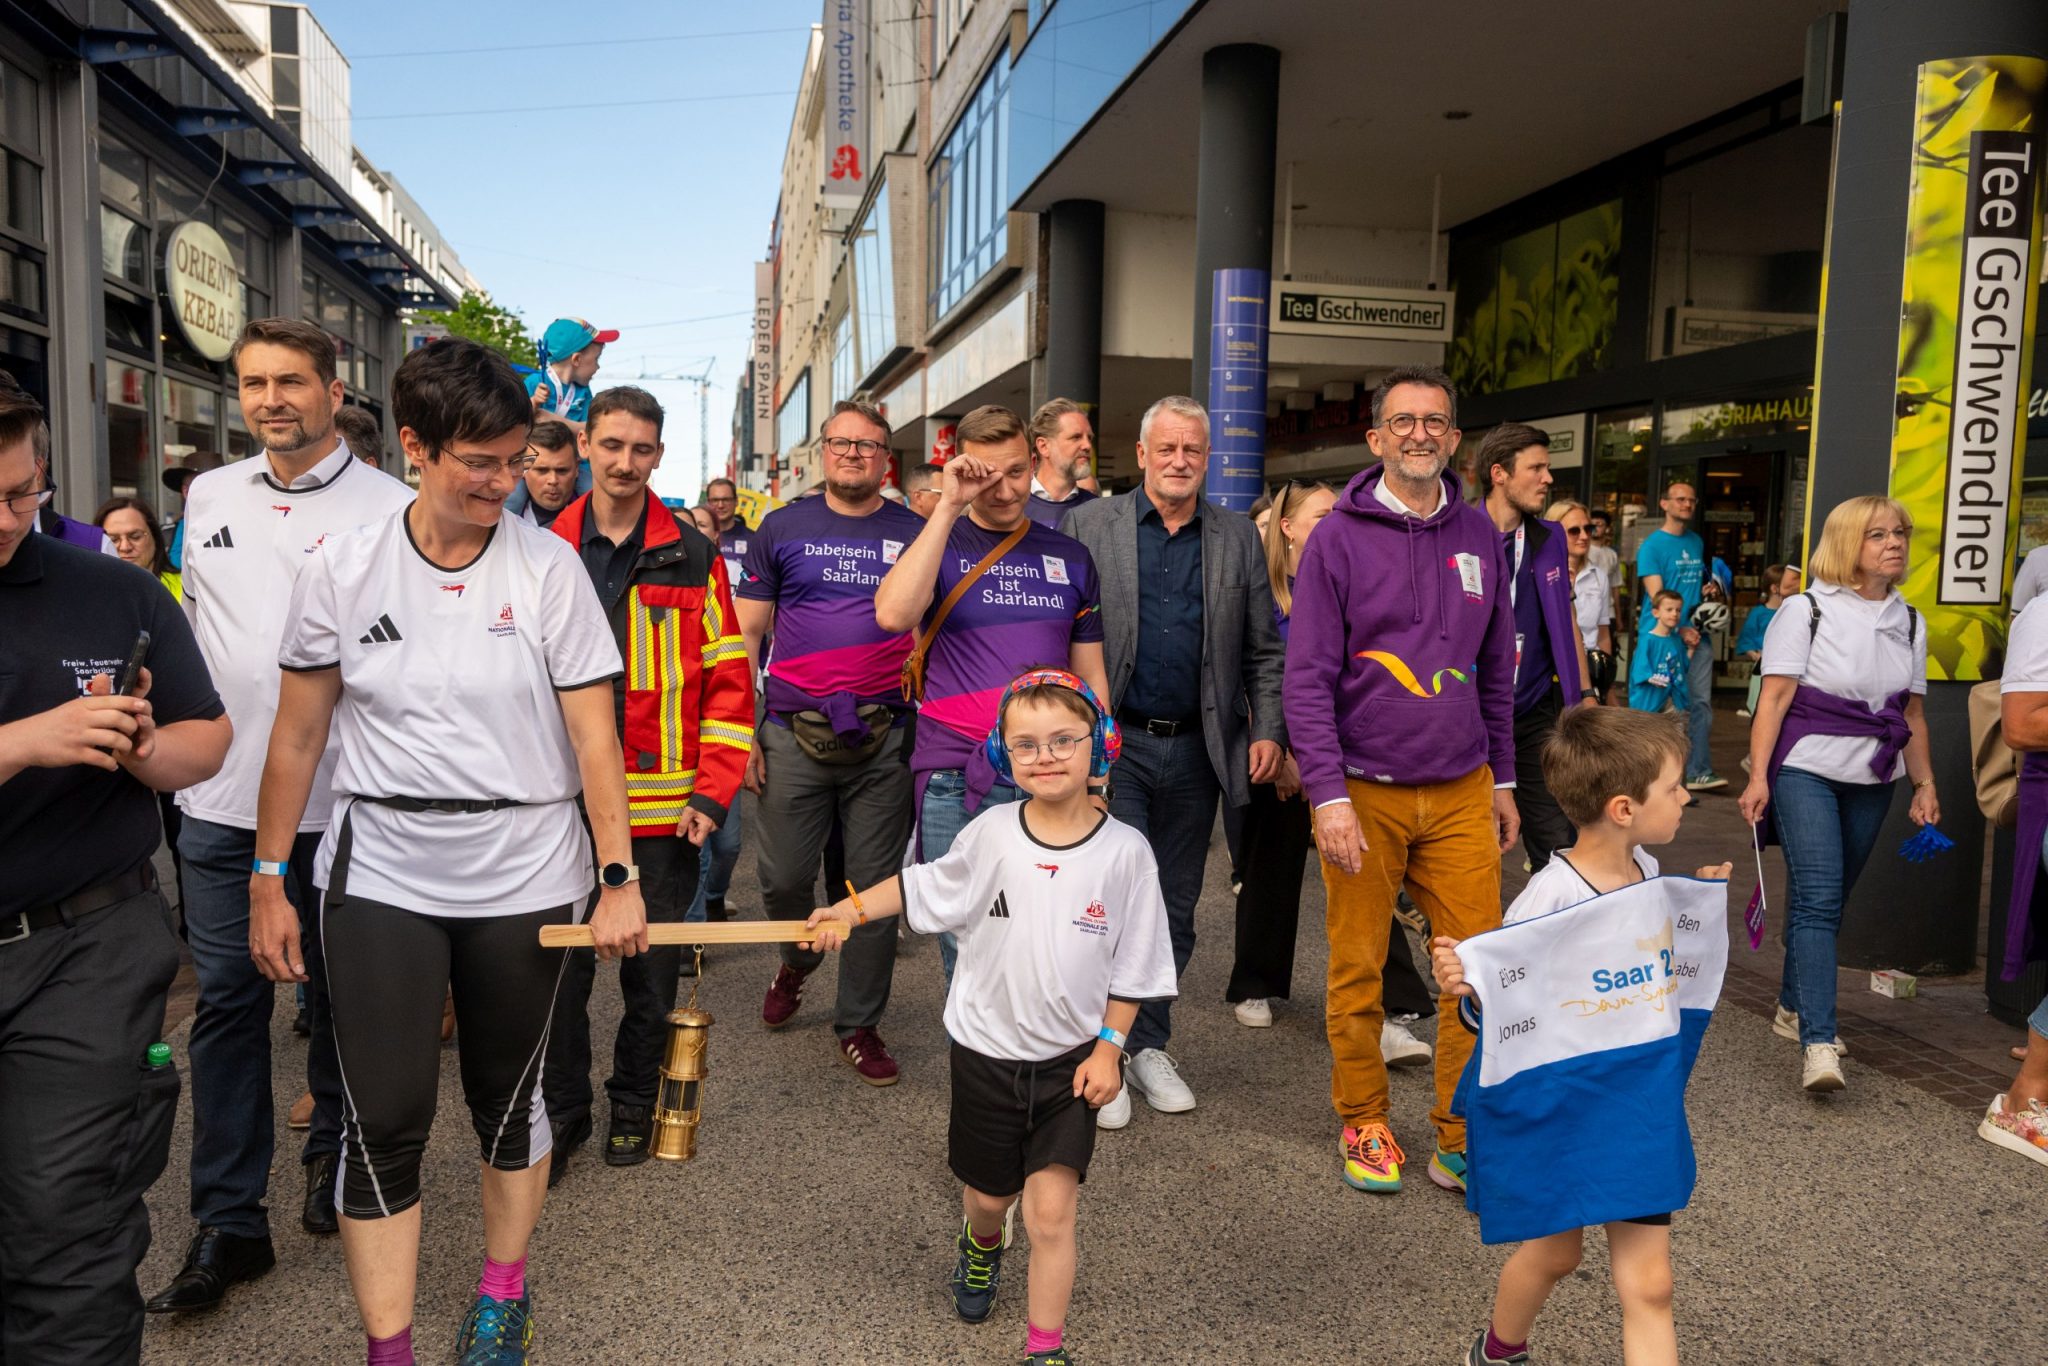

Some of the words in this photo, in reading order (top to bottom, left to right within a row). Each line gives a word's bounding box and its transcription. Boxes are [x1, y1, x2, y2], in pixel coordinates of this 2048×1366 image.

[834, 29, 857, 132] Apotheke
[1979, 142, 2031, 228] Tee
[176, 238, 237, 298] ORIENT
[183, 289, 236, 341] KEBAP
[1283, 297, 1315, 319] Tee
[1320, 301, 1441, 326] Gschwendner
[758, 297, 771, 354] LEDER
[1227, 327, 1234, 337] 6
[1225, 371, 1232, 381] 5
[758, 362, 771, 419] SPAHN
[1224, 414, 1231, 423] 4
[1953, 247, 2021, 593] Gschwendner
[1222, 456, 1229, 465] 3
[1221, 497, 1228, 506] 2
[804, 543, 877, 560] Dabeisein
[838, 557, 857, 571] ist
[960, 558, 1041, 579] Deisein
[822, 567, 884, 586] Saarlan
[999, 577, 1021, 592] ist
[982, 589, 1065, 610] Saarland!
[62, 659, 89, 667] Freiw.
[90, 658, 124, 667] Feuerwehr
[815, 733, 876, 752] adis
[1677, 913, 1700, 932] Ben
[1499, 966, 1526, 989] Elias
[1592, 962, 1655, 993] Saar
[1499, 1016, 1537, 1044] Jonas
